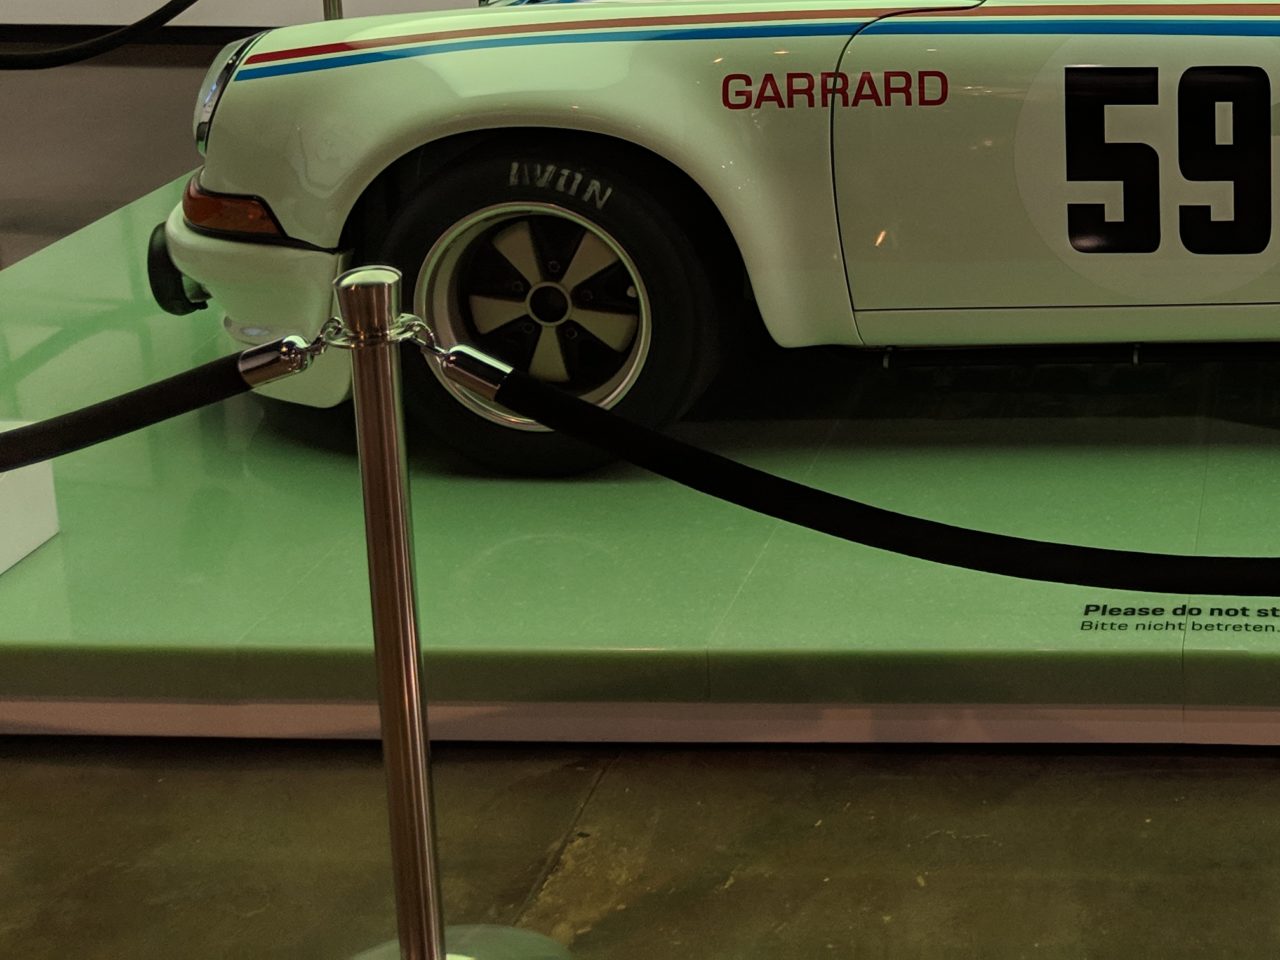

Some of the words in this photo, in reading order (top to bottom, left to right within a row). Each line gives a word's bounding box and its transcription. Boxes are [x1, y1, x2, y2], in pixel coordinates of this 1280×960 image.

[722, 70, 949, 110] GARRARD
[1064, 65, 1272, 255] 59
[1083, 604, 1165, 617] Please
[1172, 604, 1202, 617] do
[1209, 606, 1250, 618] not
[1080, 620, 1129, 632] Bitte
[1135, 620, 1186, 632] nicht
[1191, 621, 1280, 633] betreten.
